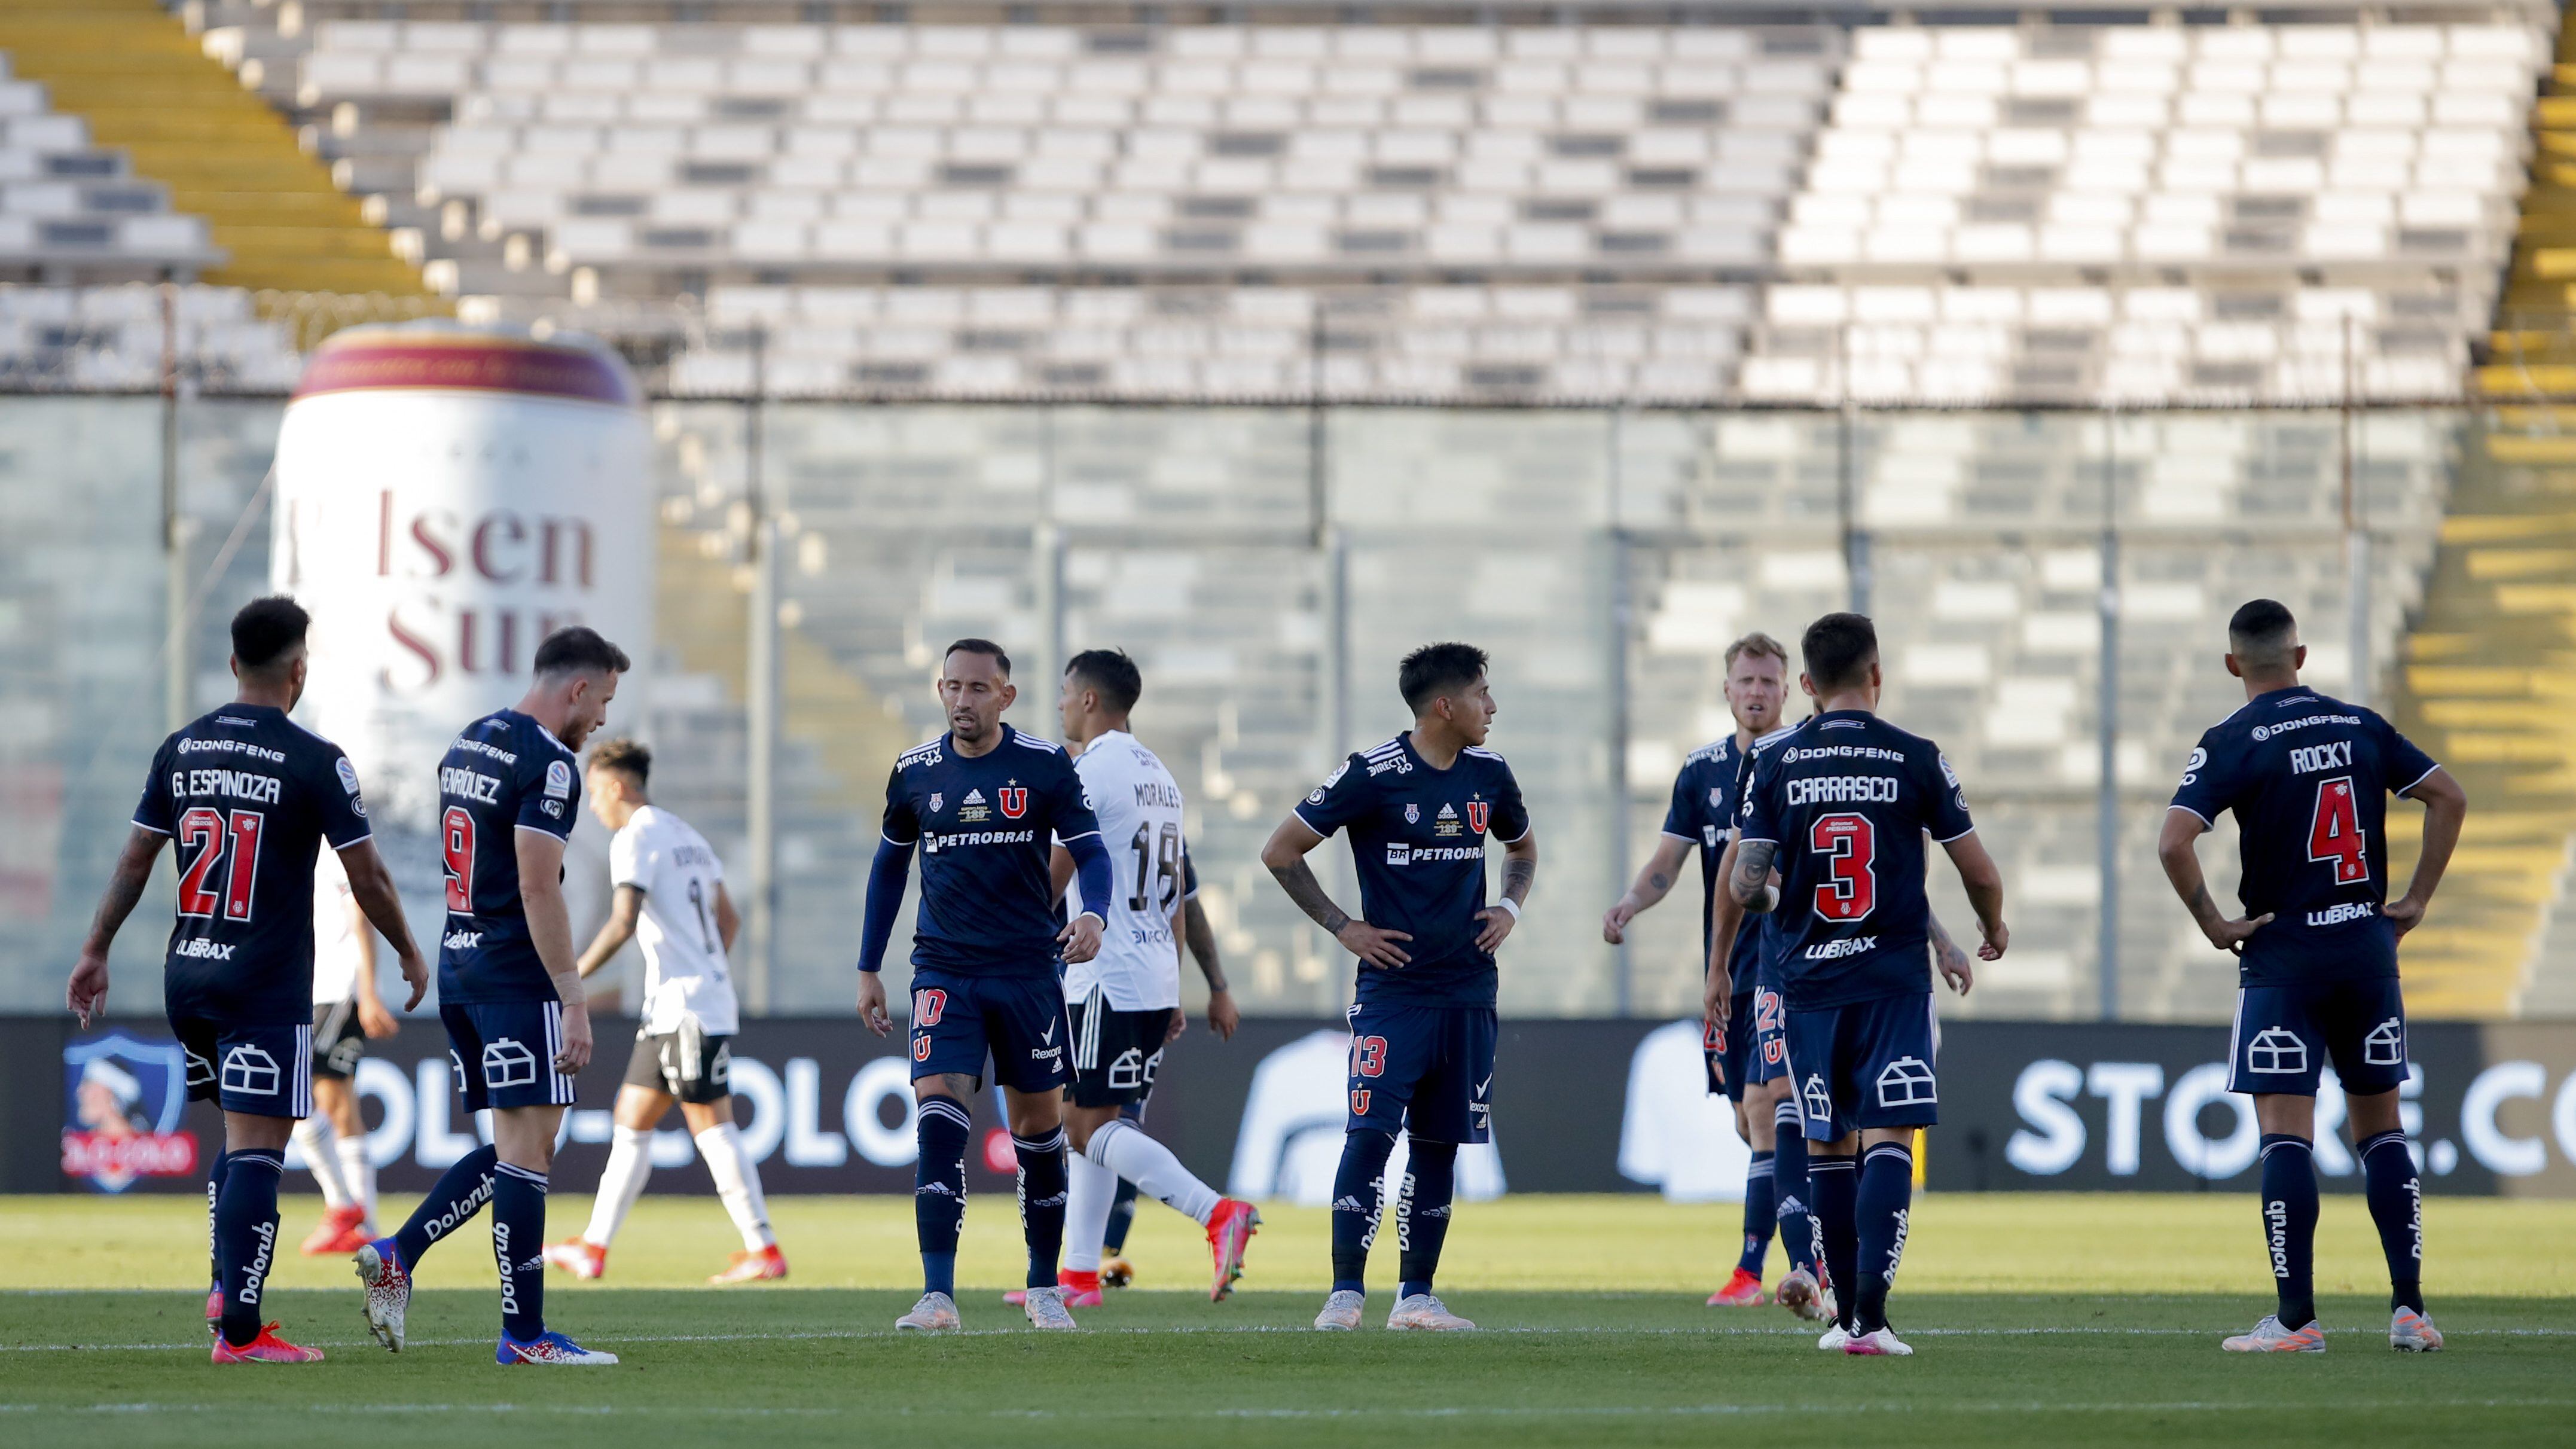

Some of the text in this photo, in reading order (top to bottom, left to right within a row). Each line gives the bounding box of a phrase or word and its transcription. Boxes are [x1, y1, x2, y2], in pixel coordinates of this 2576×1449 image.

[2270, 715, 2361, 735] DONGFENG
[191, 740, 286, 762] DONGFENG
[456, 739, 517, 764] DONGFENG
[897, 748, 941, 773] DIRECTV
[925, 754, 943, 766] GO
[1800, 746, 1904, 762] DONGFENG
[2290, 740, 2352, 775] ROCKY
[1366, 754, 1407, 777] DIRECTV
[1397, 762, 1413, 774] GO
[172, 769, 281, 804] G. ESPINOZA
[1134, 783, 1180, 809] MORALES
[1787, 776, 1899, 806] CARRASCO
[938, 830, 1034, 847] PETROBRAS
[2307, 776, 2370, 886] 4
[177, 807, 264, 922] 21
[443, 805, 476, 917] 9
[1129, 821, 1179, 912] 18
[1810, 812, 1876, 923] 3
[2307, 902, 2376, 926] LUBRAX
[176, 937, 236, 960] LUBRAX
[1805, 935, 1878, 959] LUBRAX
[912, 989, 947, 1029] 10
[1351, 1035, 1388, 1078] 13
[239, 1221, 275, 1304] Dolorub
[493, 1222, 520, 1314] Dolorub
